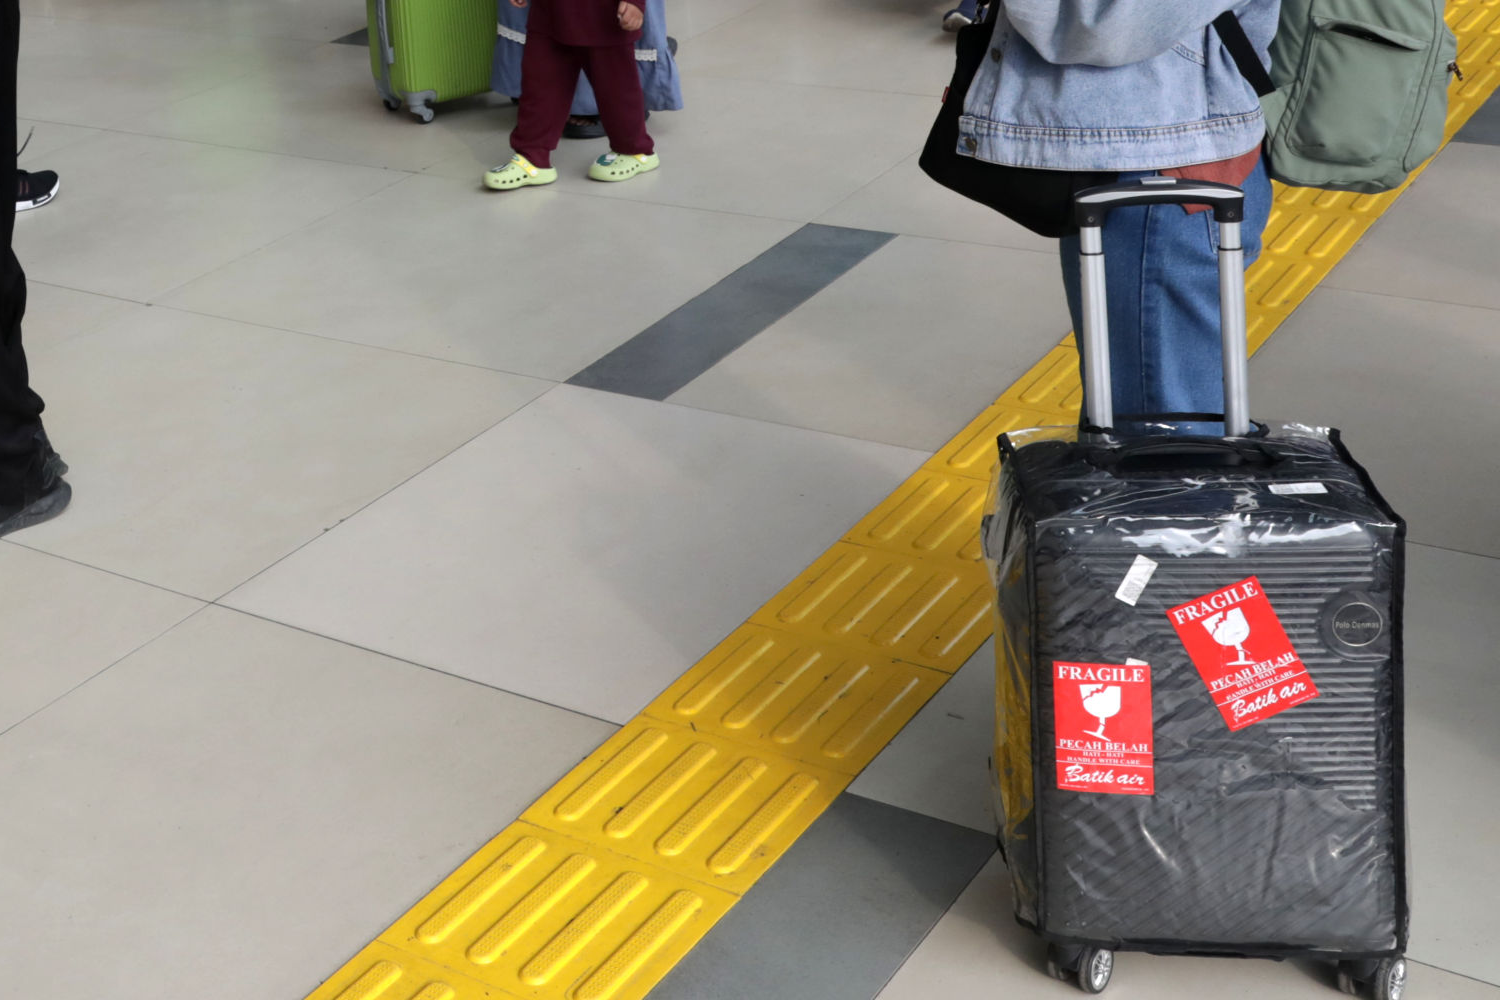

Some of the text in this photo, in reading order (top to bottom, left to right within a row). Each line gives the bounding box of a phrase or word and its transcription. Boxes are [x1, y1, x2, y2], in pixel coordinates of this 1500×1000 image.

[1172, 581, 1259, 626] FRAGILE
[1057, 665, 1145, 683] FRAGILE
[1209, 651, 1296, 691] PECAH BELAH
[1231, 681, 1307, 720] Batik air
[1059, 738, 1148, 752] PECAH BELAH
[1067, 756, 1097, 764] HANDLE
[1064, 764, 1145, 786] Batik air
